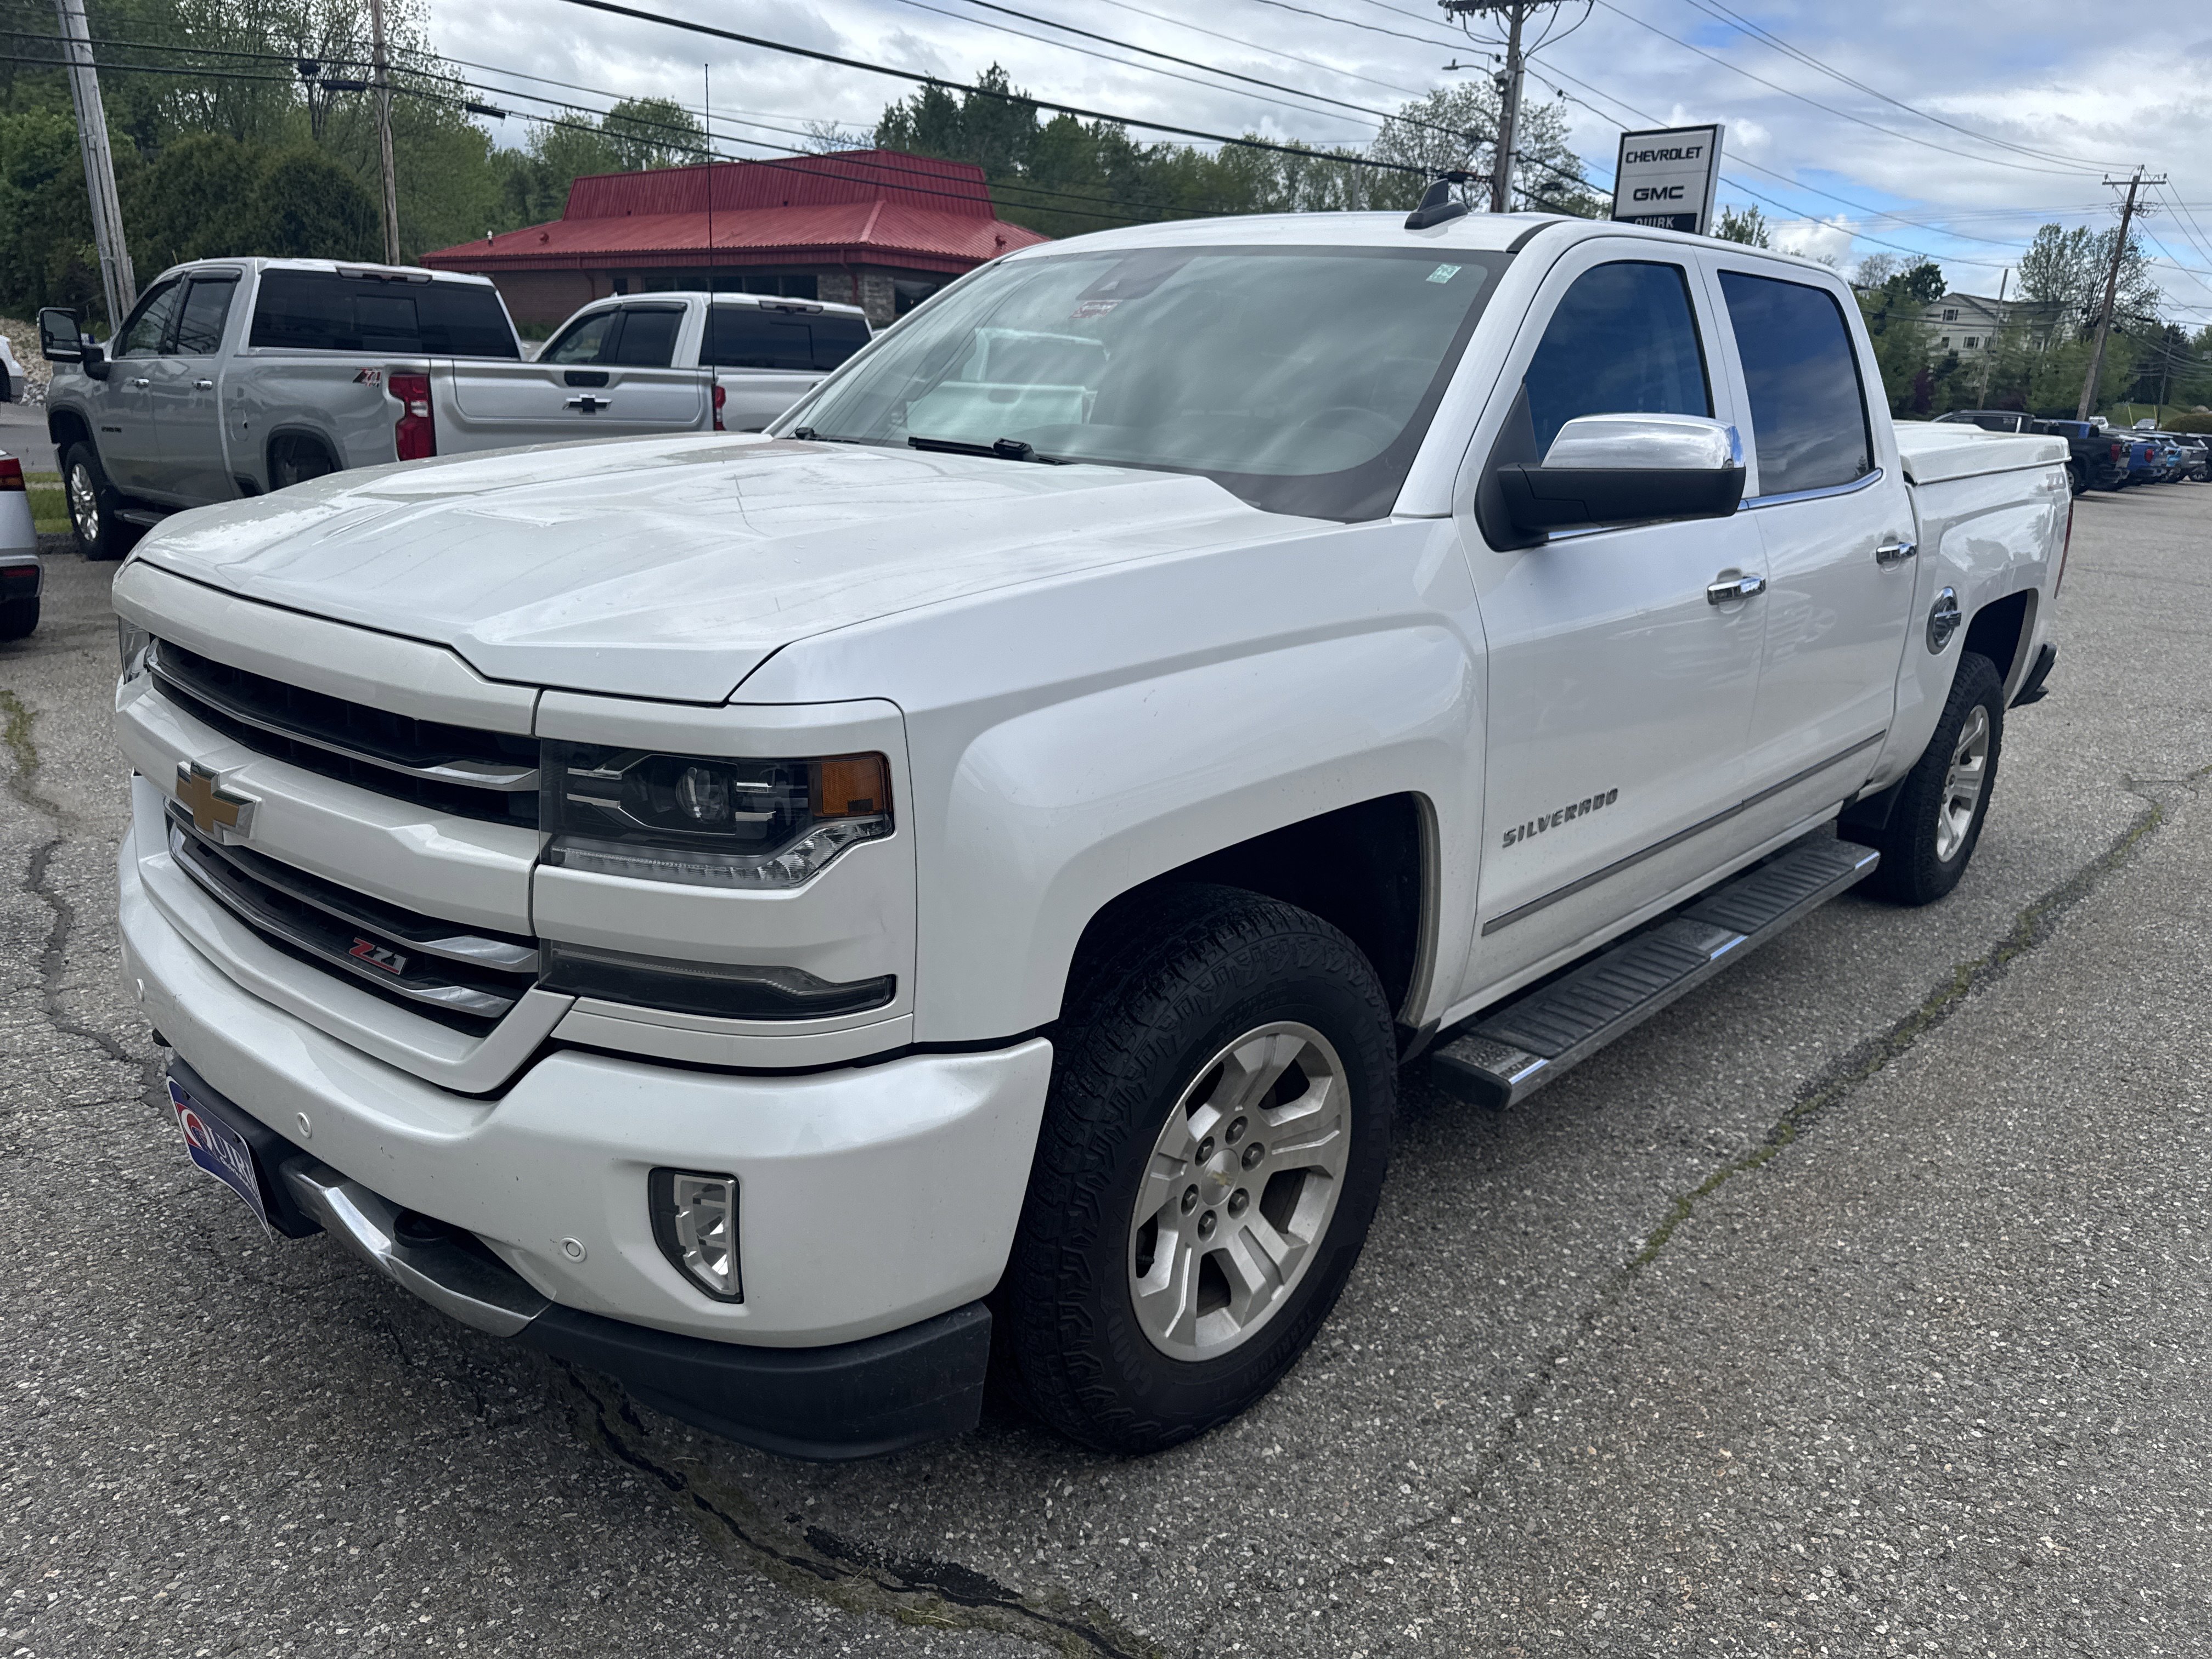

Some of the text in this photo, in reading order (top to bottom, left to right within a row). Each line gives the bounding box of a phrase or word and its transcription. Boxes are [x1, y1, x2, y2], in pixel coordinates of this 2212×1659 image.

[1625, 146, 1703, 164] CHEVROLET
[1633, 185, 1685, 201] GMC
[1502, 787, 1618, 849] SILVERADO
[349, 937, 407, 975] Z71
[180, 1108, 260, 1197] QUIRK
